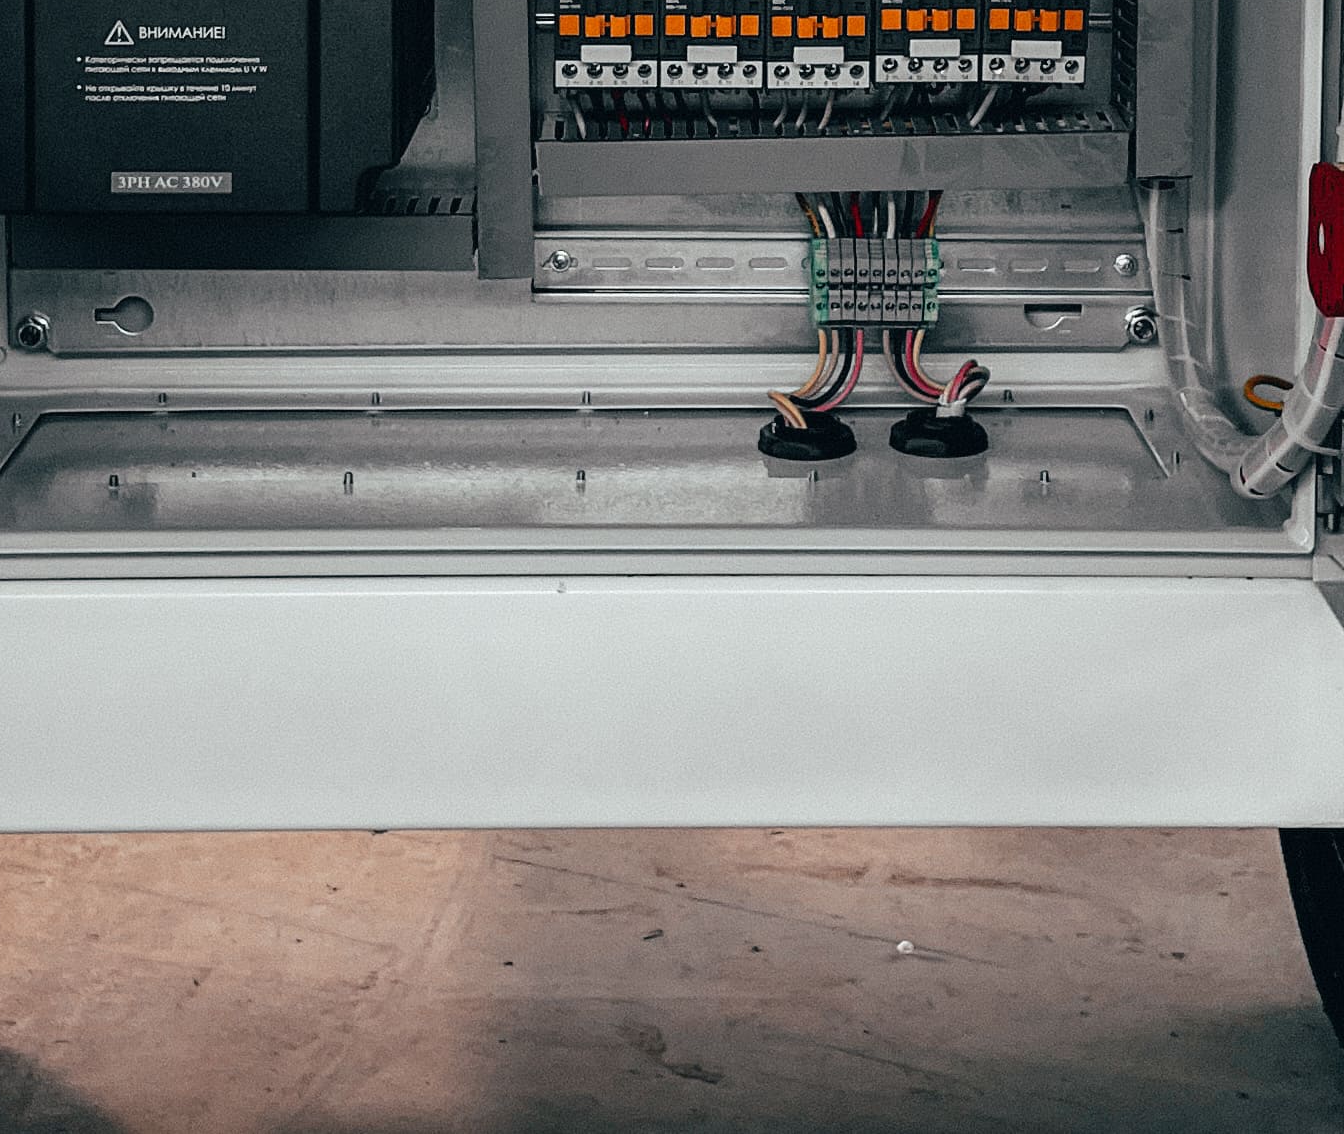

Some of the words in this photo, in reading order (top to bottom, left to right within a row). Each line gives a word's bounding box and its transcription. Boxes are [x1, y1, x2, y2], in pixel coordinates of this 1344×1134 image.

[138, 26, 226, 39] ВНИМАНИЕ!
[117, 176, 150, 189] 3PH
[154, 176, 179, 188] AC
[182, 176, 224, 189] 380V
